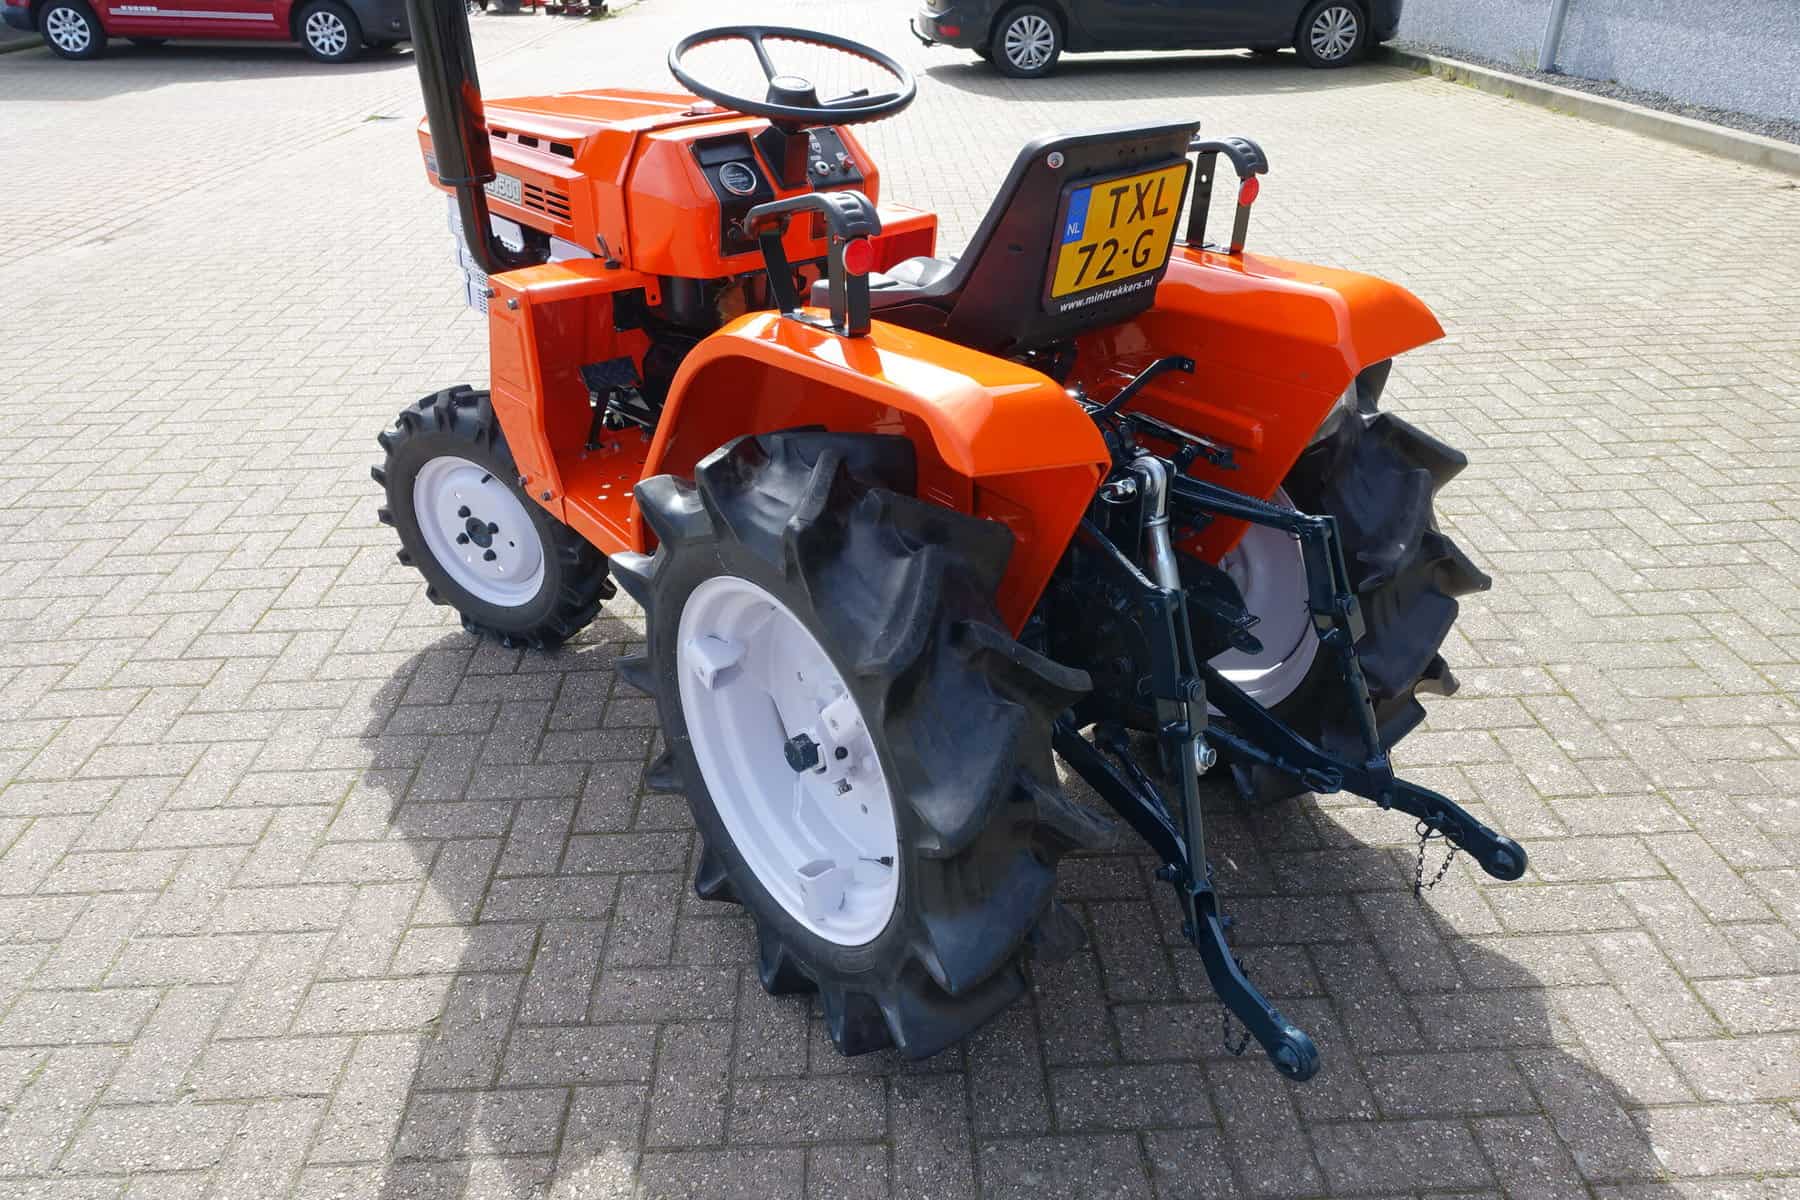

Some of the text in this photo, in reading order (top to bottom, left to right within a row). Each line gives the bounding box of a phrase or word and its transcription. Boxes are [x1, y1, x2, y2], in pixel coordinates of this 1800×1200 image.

[1109, 176, 1169, 229] TXL
[1067, 222, 1080, 236] NL
[1060, 276, 1154, 312] www.minitrekkers.nl
